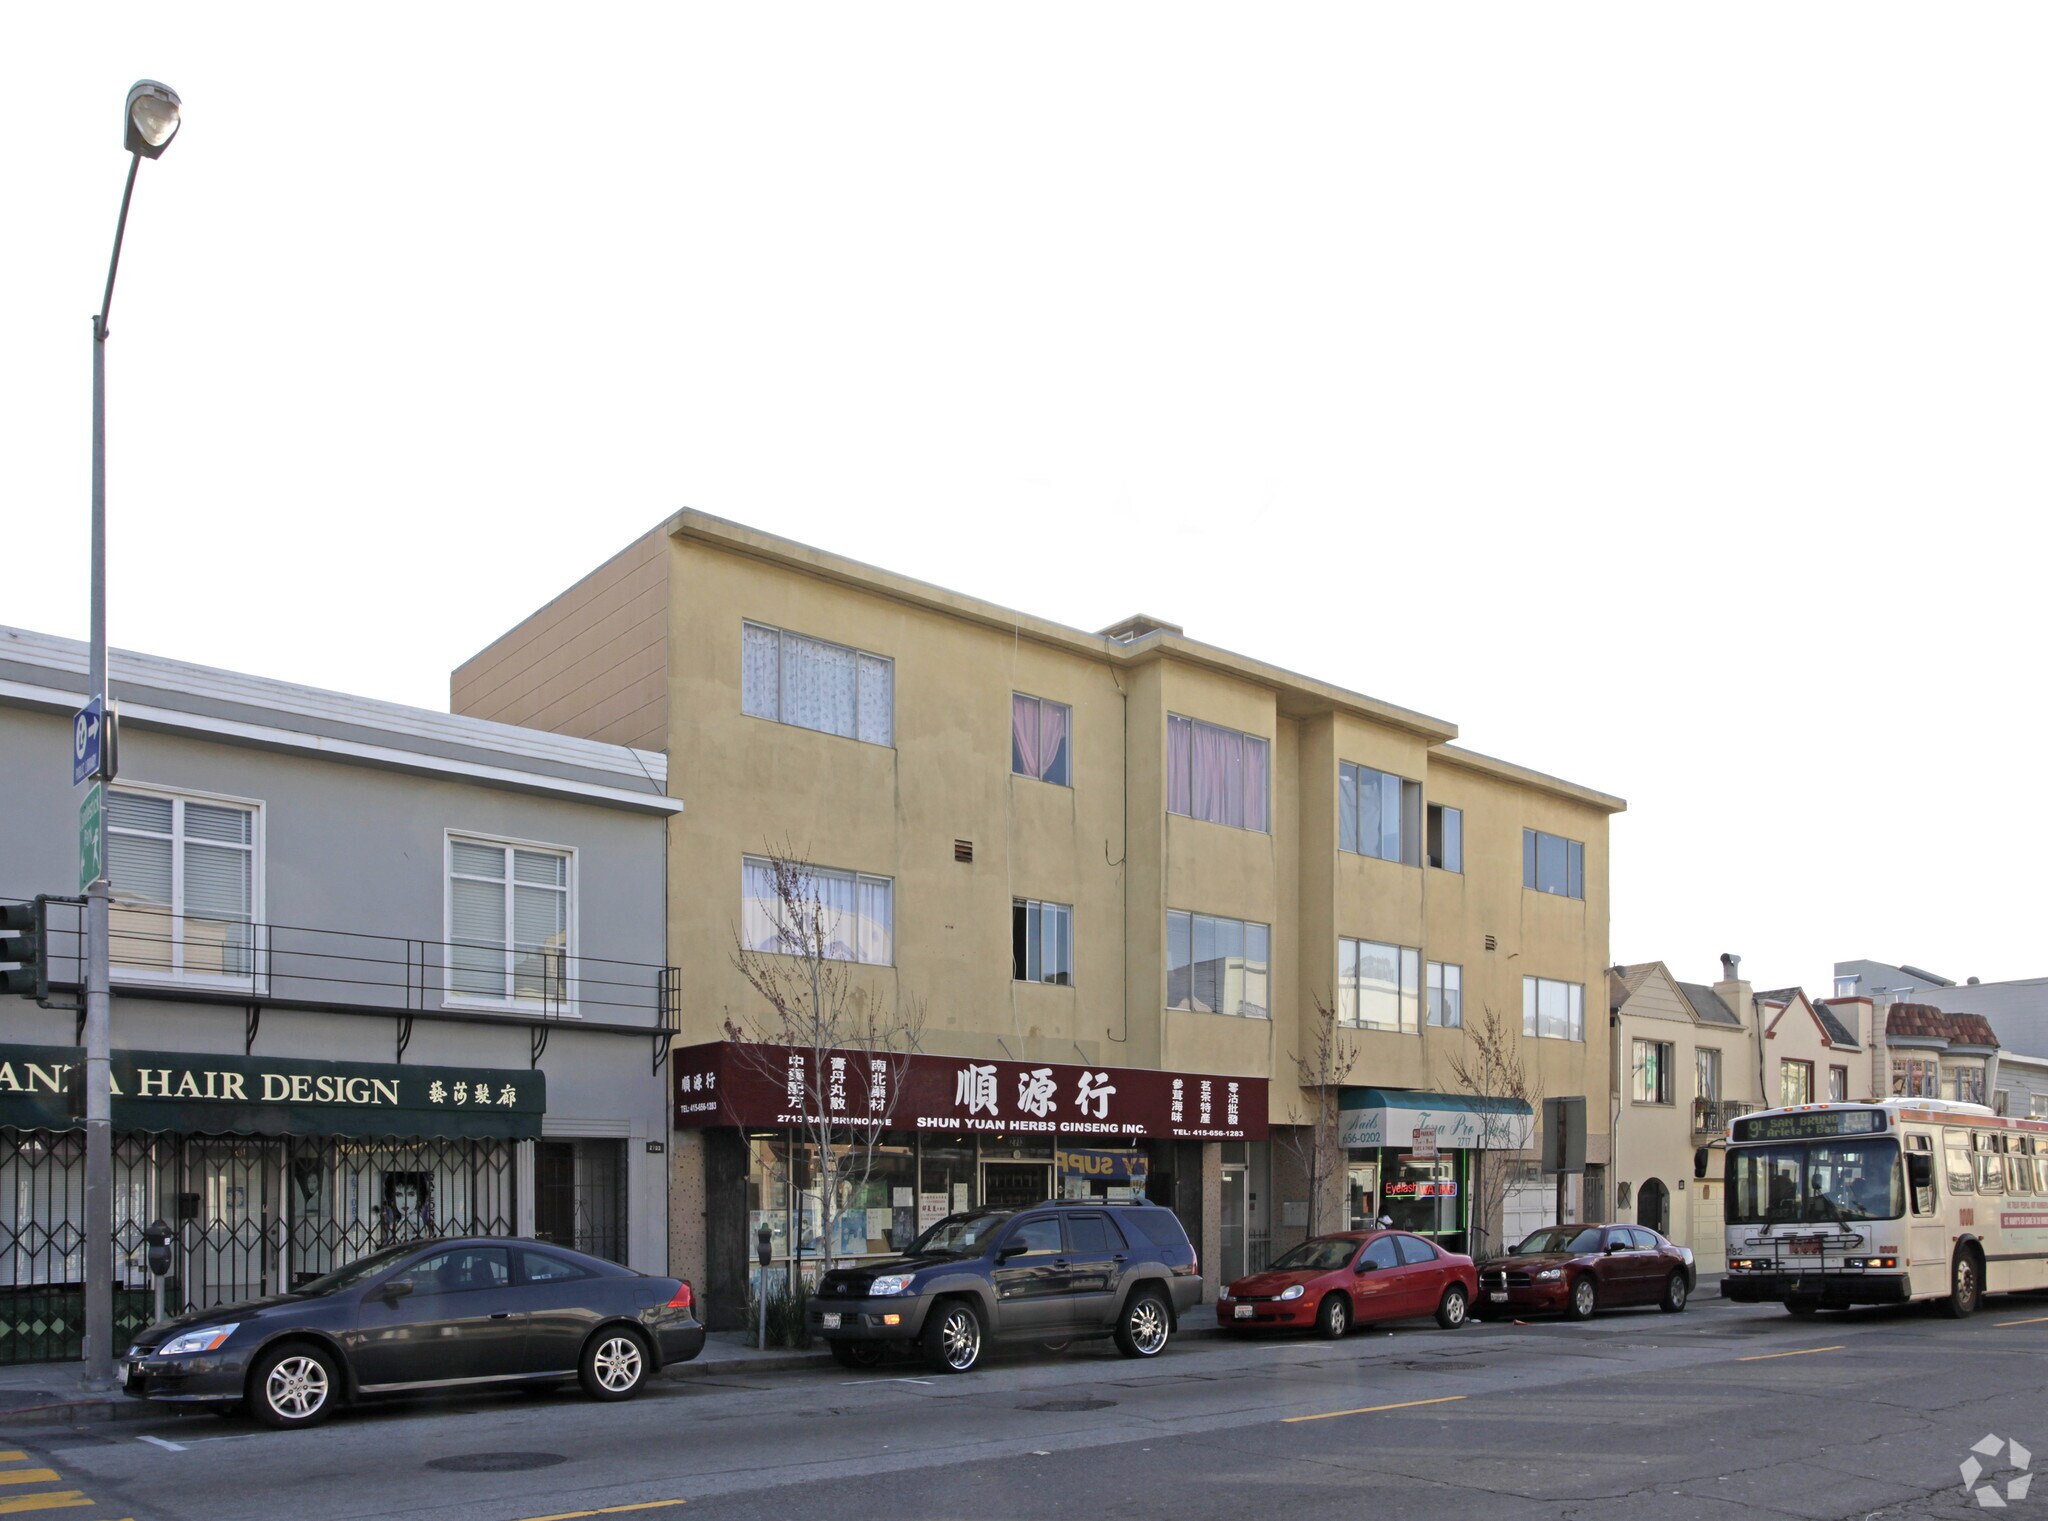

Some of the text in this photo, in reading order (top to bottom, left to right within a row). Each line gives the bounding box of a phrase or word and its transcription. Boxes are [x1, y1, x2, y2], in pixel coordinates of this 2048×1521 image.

[0, 1061, 400, 1105] ANA HAIR DESIGN
[955, 1063, 1116, 1119] 順源行
[777, 1114, 892, 1126] 2713 SAN BRUNO AVE
[916, 1117, 1147, 1135] SHUN YUAN HERBS GINSENG INC.
[1346, 1112, 1379, 1130] Nails
[1770, 1118, 1794, 1128] SAN
[1800, 1114, 1839, 1126] BRUNO
[1172, 1128, 1244, 1137] TEL: 415-656-1283
[1342, 1132, 1380, 1143] 656-0202
[1767, 1126, 1803, 1137] Arleta
[1457, 1137, 1471, 1147] 2717
[1385, 1181, 1456, 1196] Eyelash WAING
